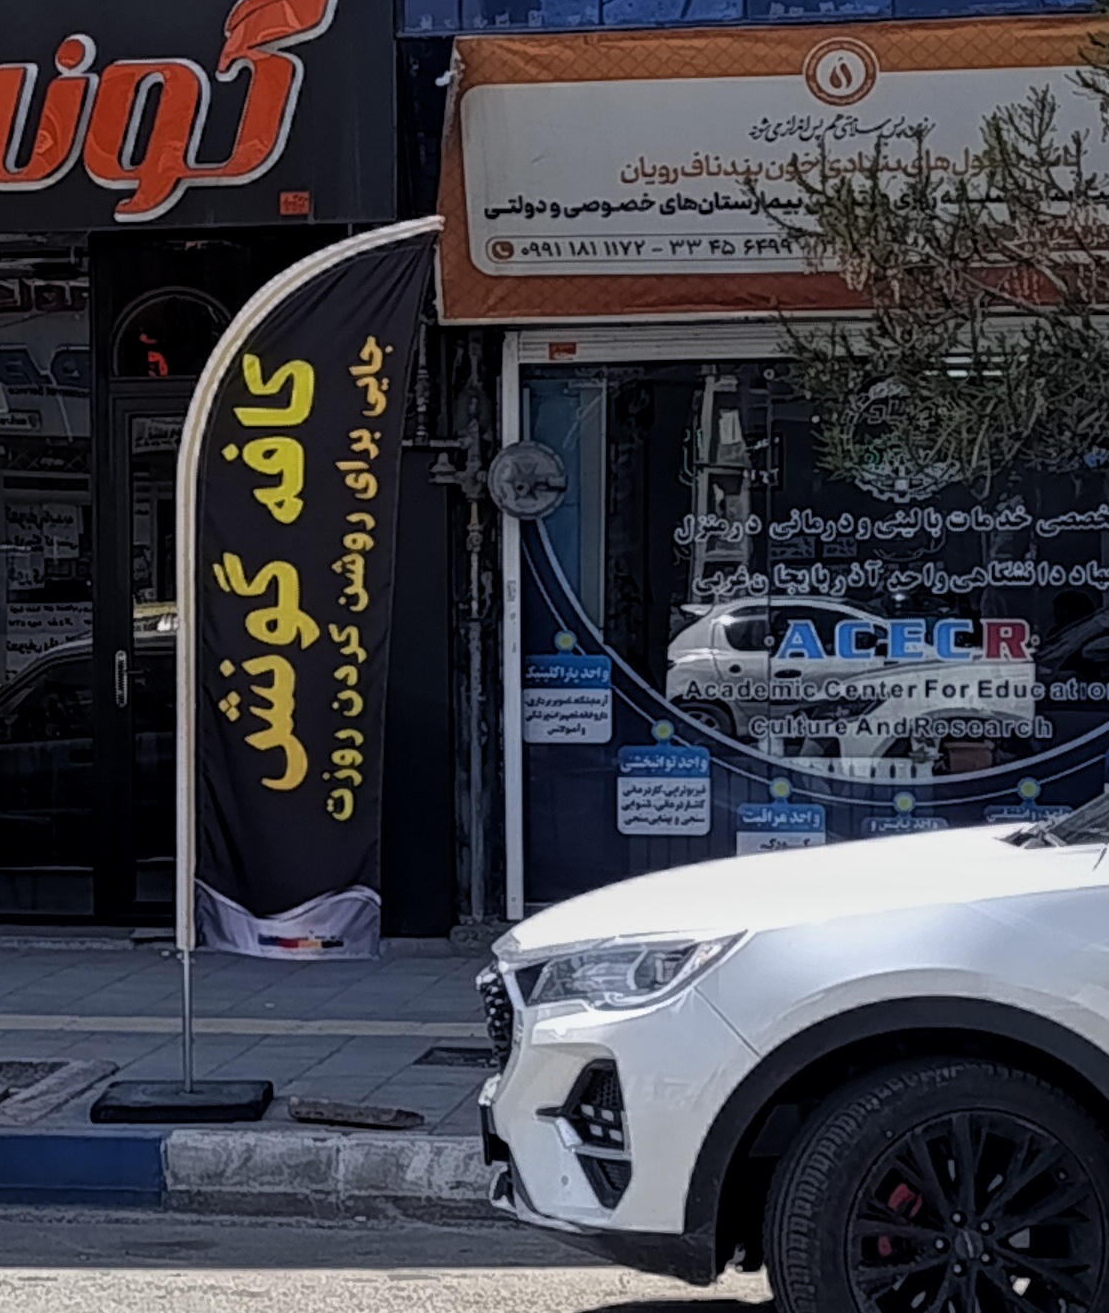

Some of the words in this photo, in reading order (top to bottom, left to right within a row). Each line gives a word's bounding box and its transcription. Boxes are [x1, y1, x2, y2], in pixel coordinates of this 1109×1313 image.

[620, 156, 679, 184] رویان
[681, 151, 721, 177] ناف
[766, 152, 820, 182] خون
[484, 193, 548, 219] دولتی
[550, 202, 561, 218] و
[563, 191, 656, 218] خصوصی
[568, 239, 597, 256] ۱۸۱
[604, 239, 646, 256] ۱۱۷۲
[708, 239, 736, 256] ۴۵
[348, 335, 393, 417] جایی
[220, 353, 315, 525] کافه
[334, 428, 383, 500] برای
[769, 508, 855, 541] درمانی
[855, 515, 872, 540] و
[945, 504, 1033, 534] خدمات
[330, 511, 377, 613] روشن
[887, 562, 949, 594] واحد
[777, 618, 1032, 662] ACECR
[213, 551, 321, 791] گونش
[327, 622, 369, 719] کردن
[683, 679, 821, 701] Academic
[824, 679, 923, 701] Center
[924, 679, 971, 700] For
[977, 679, 1109, 701] Educatio
[749, 716, 847, 739] Culture
[855, 716, 911, 739] And
[913, 716, 1054, 739] Research
[321, 728, 365, 822] روزت
[678, 755, 709, 773] واحد
[789, 809, 821, 828] واحد
